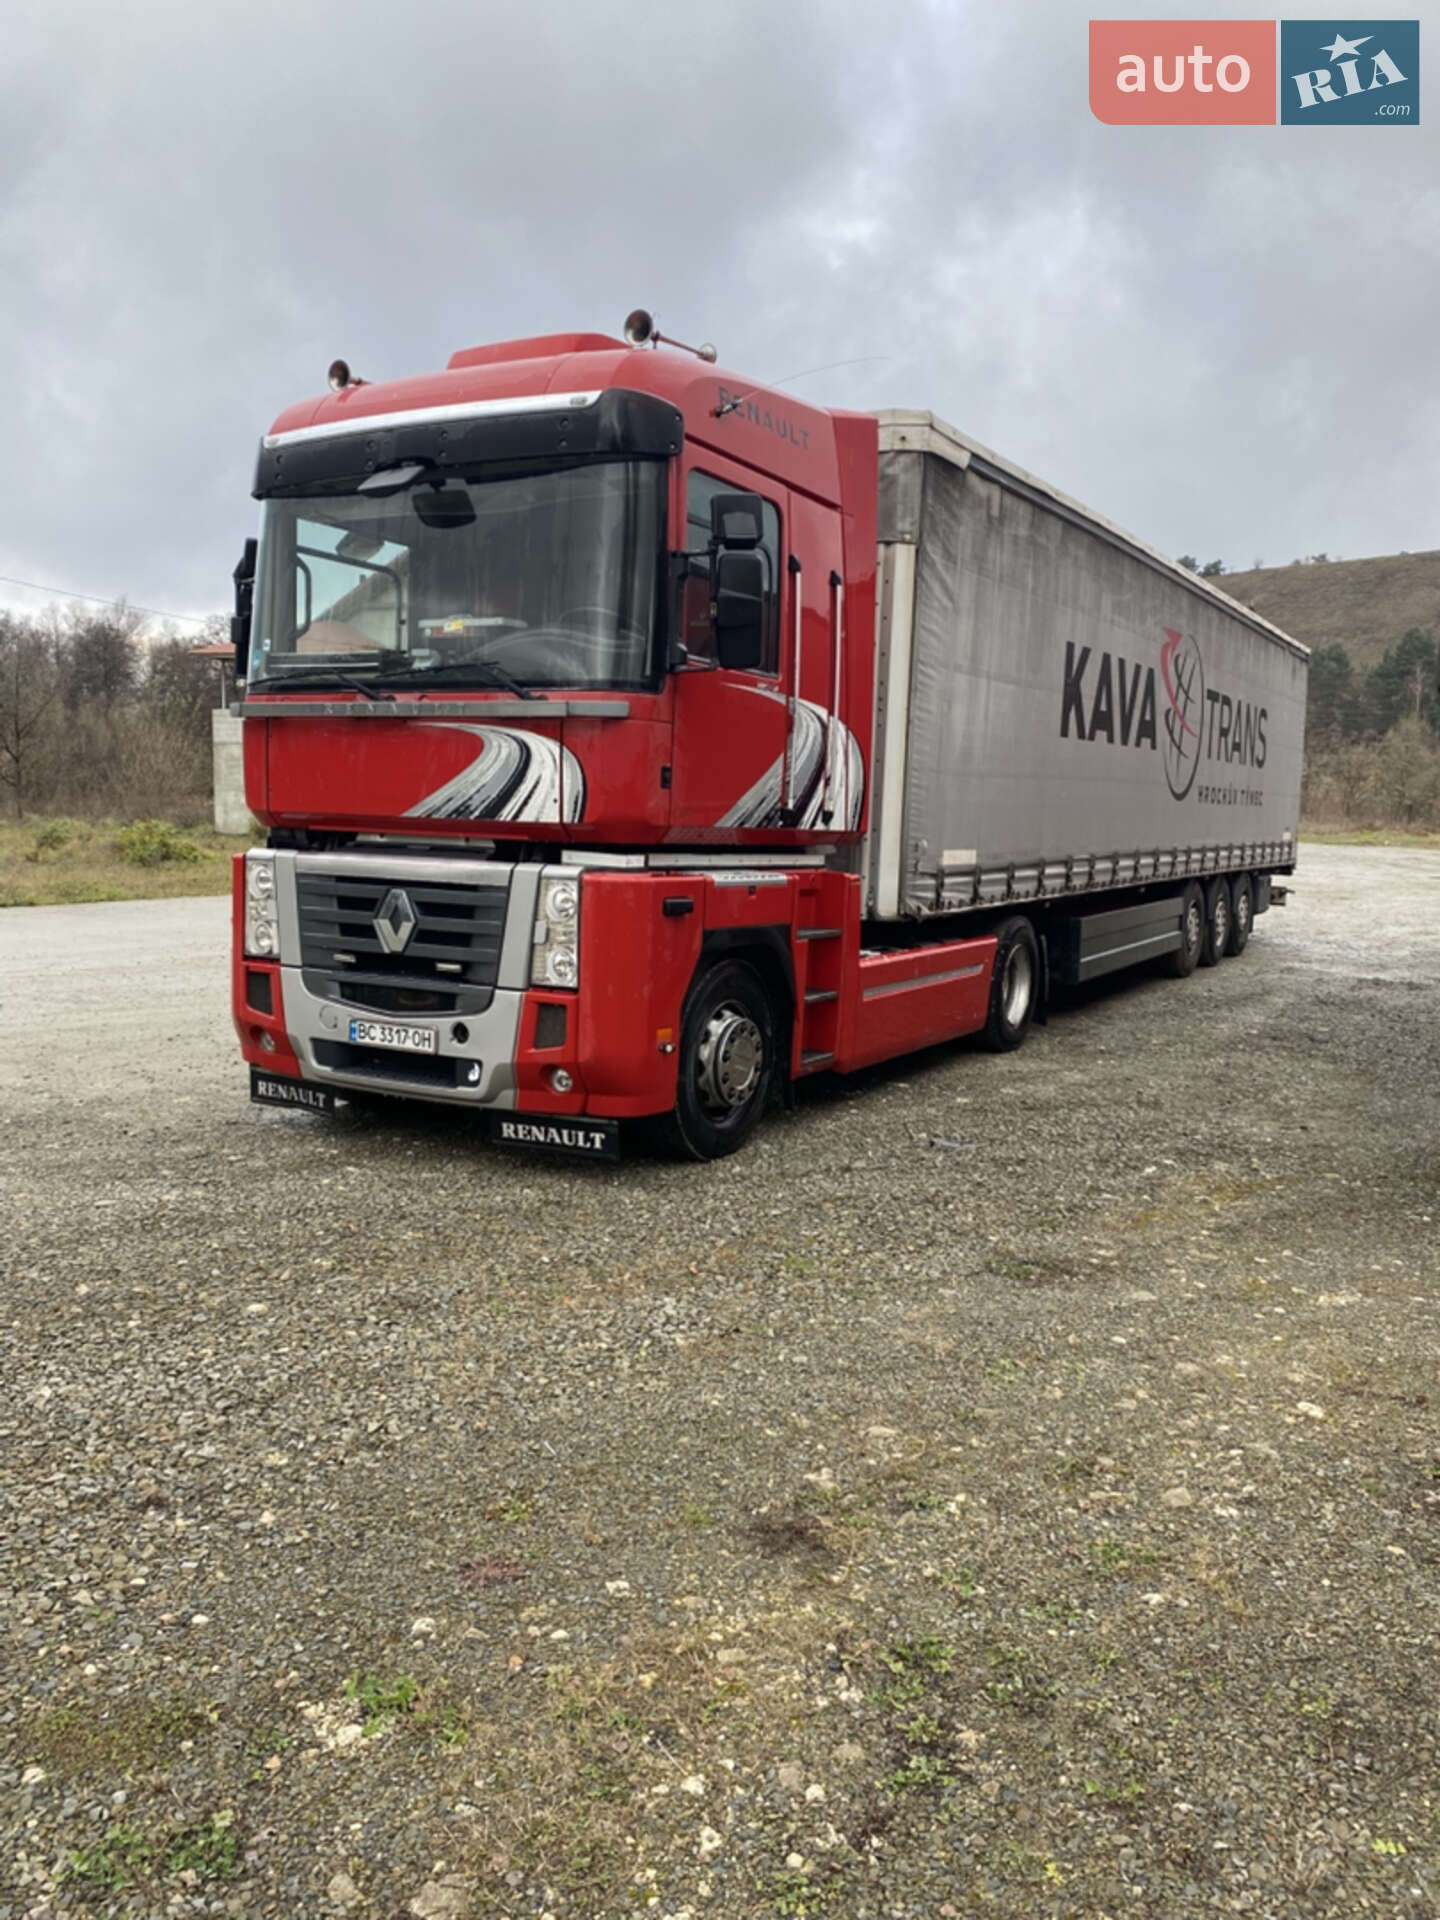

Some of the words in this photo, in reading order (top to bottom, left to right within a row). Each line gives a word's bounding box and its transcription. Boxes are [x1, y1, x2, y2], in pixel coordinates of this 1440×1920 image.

[1060, 641, 1157, 750] KAVA
[1206, 688, 1268, 769] TRANS
[358, 1023, 376, 1040] BC
[257, 1081, 326, 1108] RENAULT
[501, 1122, 605, 1149] RENAULT
